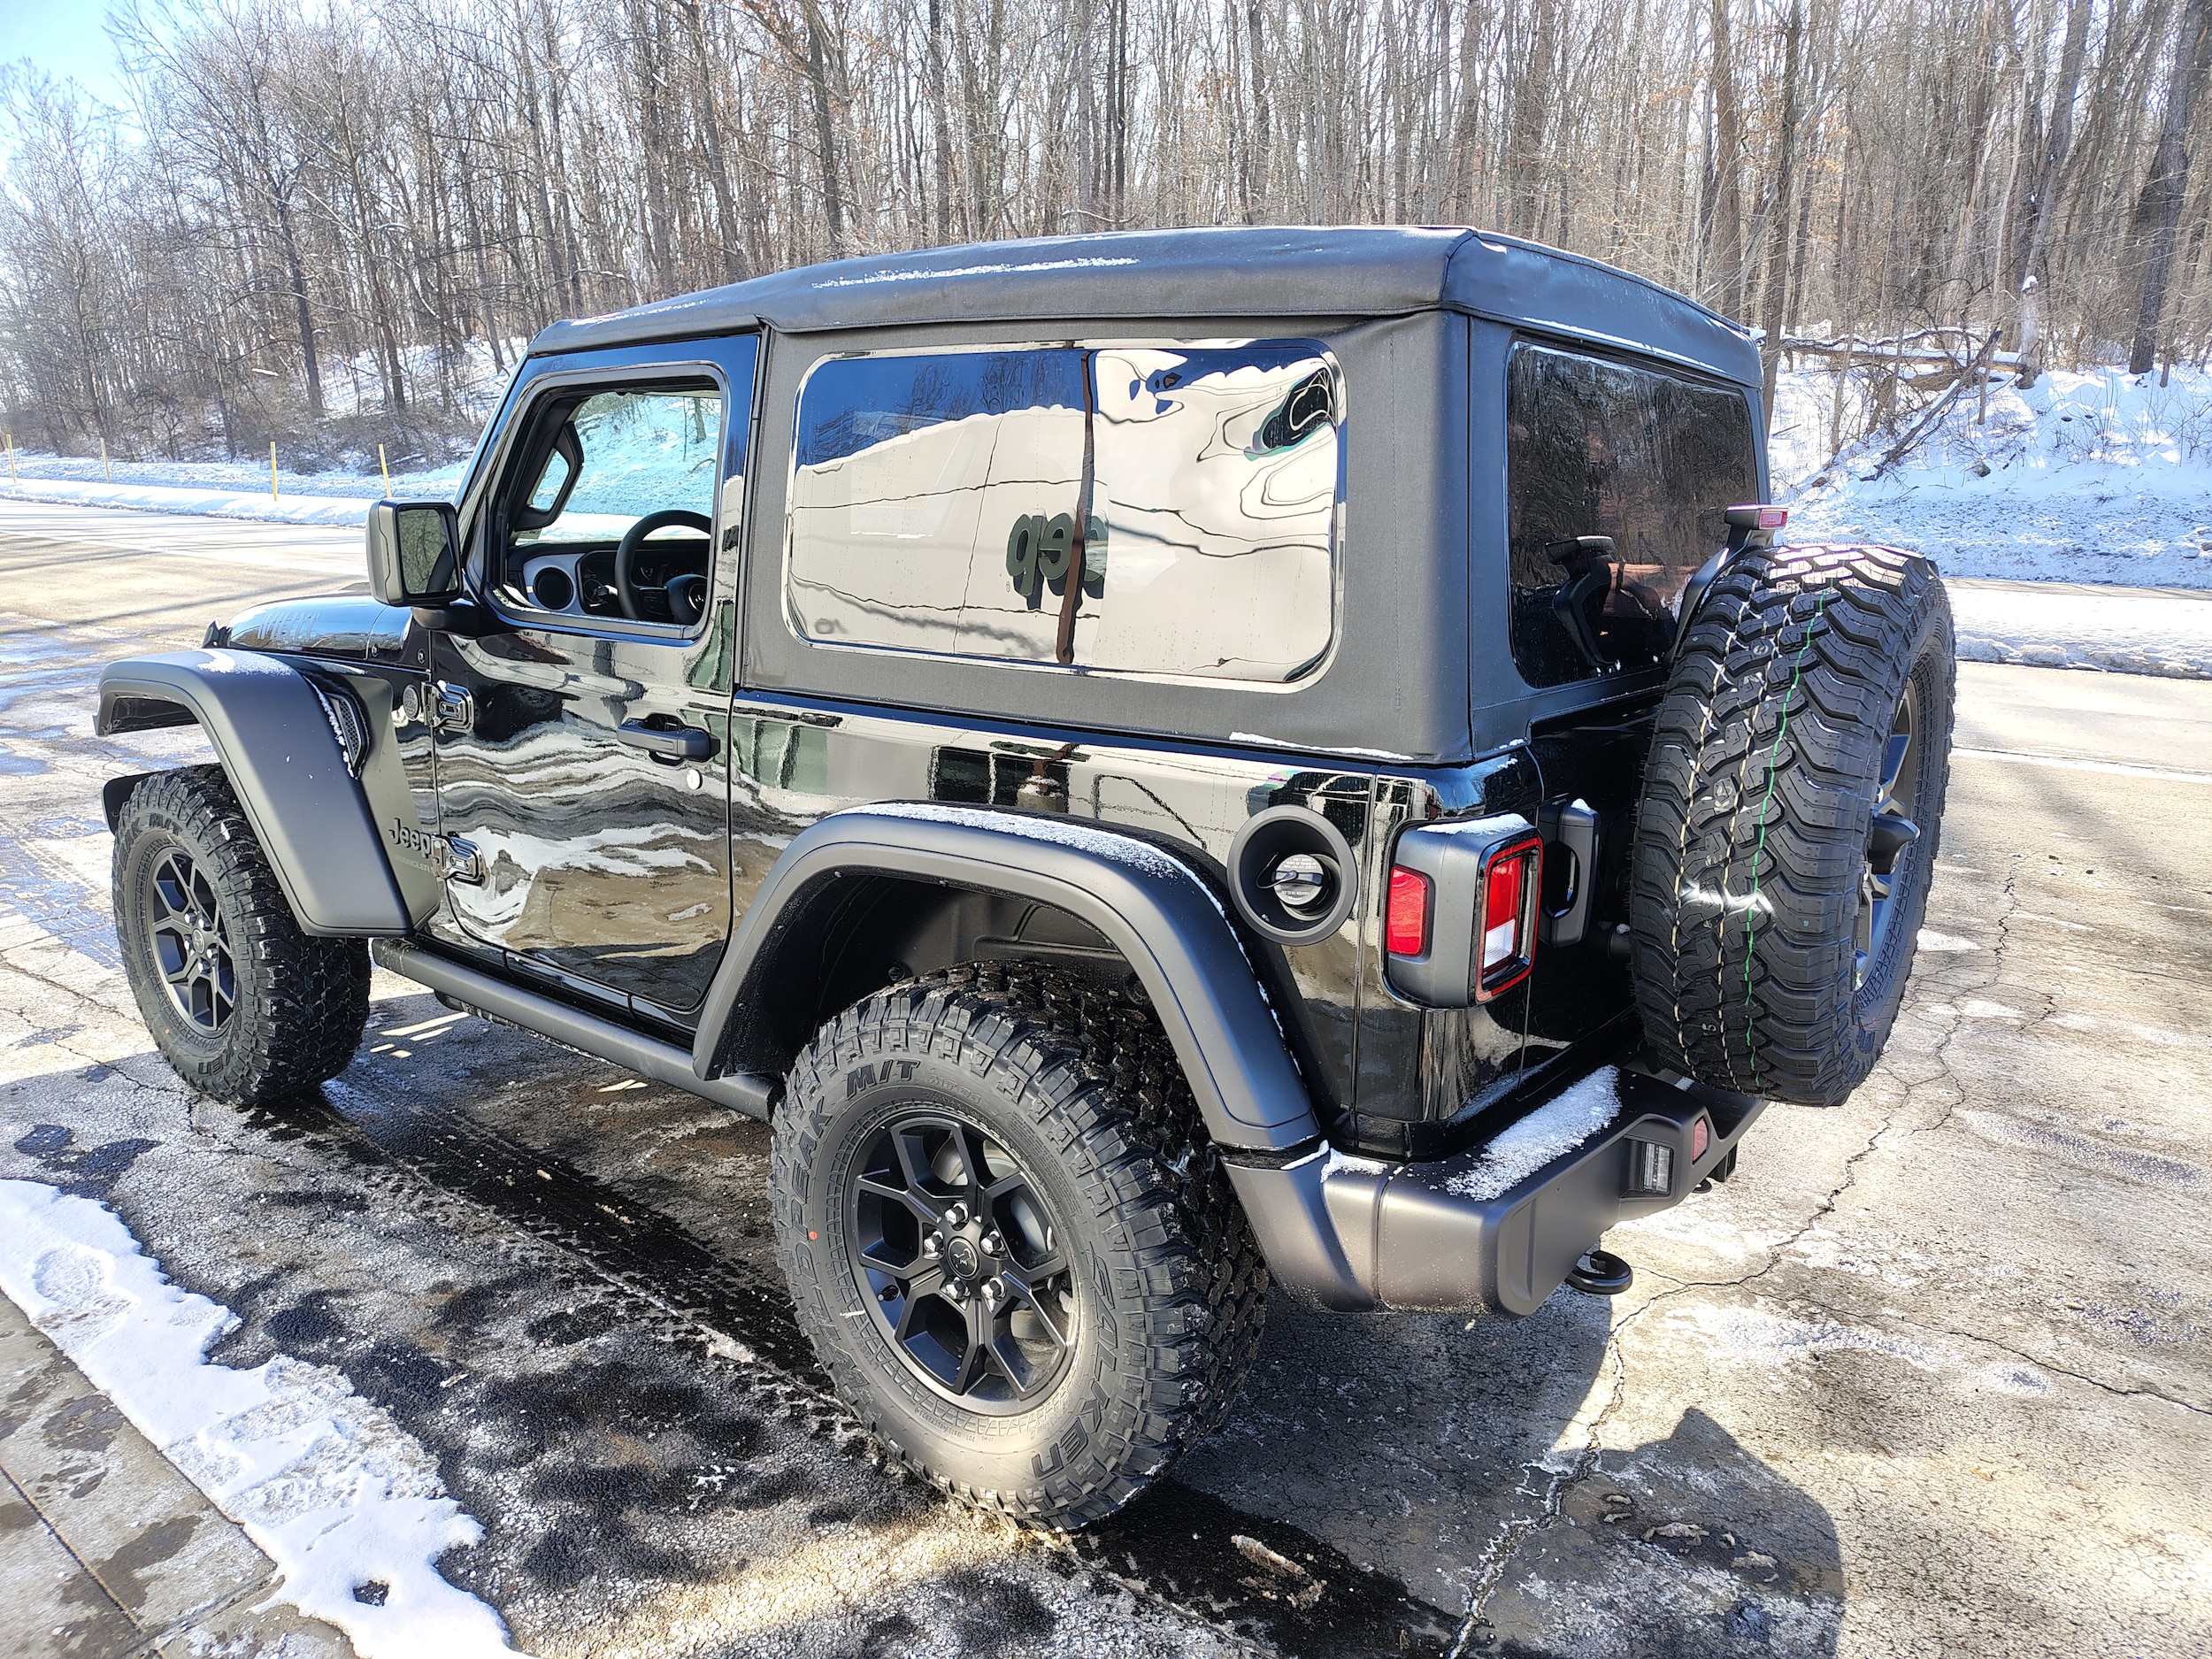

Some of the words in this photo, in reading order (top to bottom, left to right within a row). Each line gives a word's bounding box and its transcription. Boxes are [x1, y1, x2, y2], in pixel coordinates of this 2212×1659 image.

[388, 818, 432, 859] Jeep
[847, 1058, 921, 1101] M/T
[1031, 1241, 1118, 1480] FALKEN
